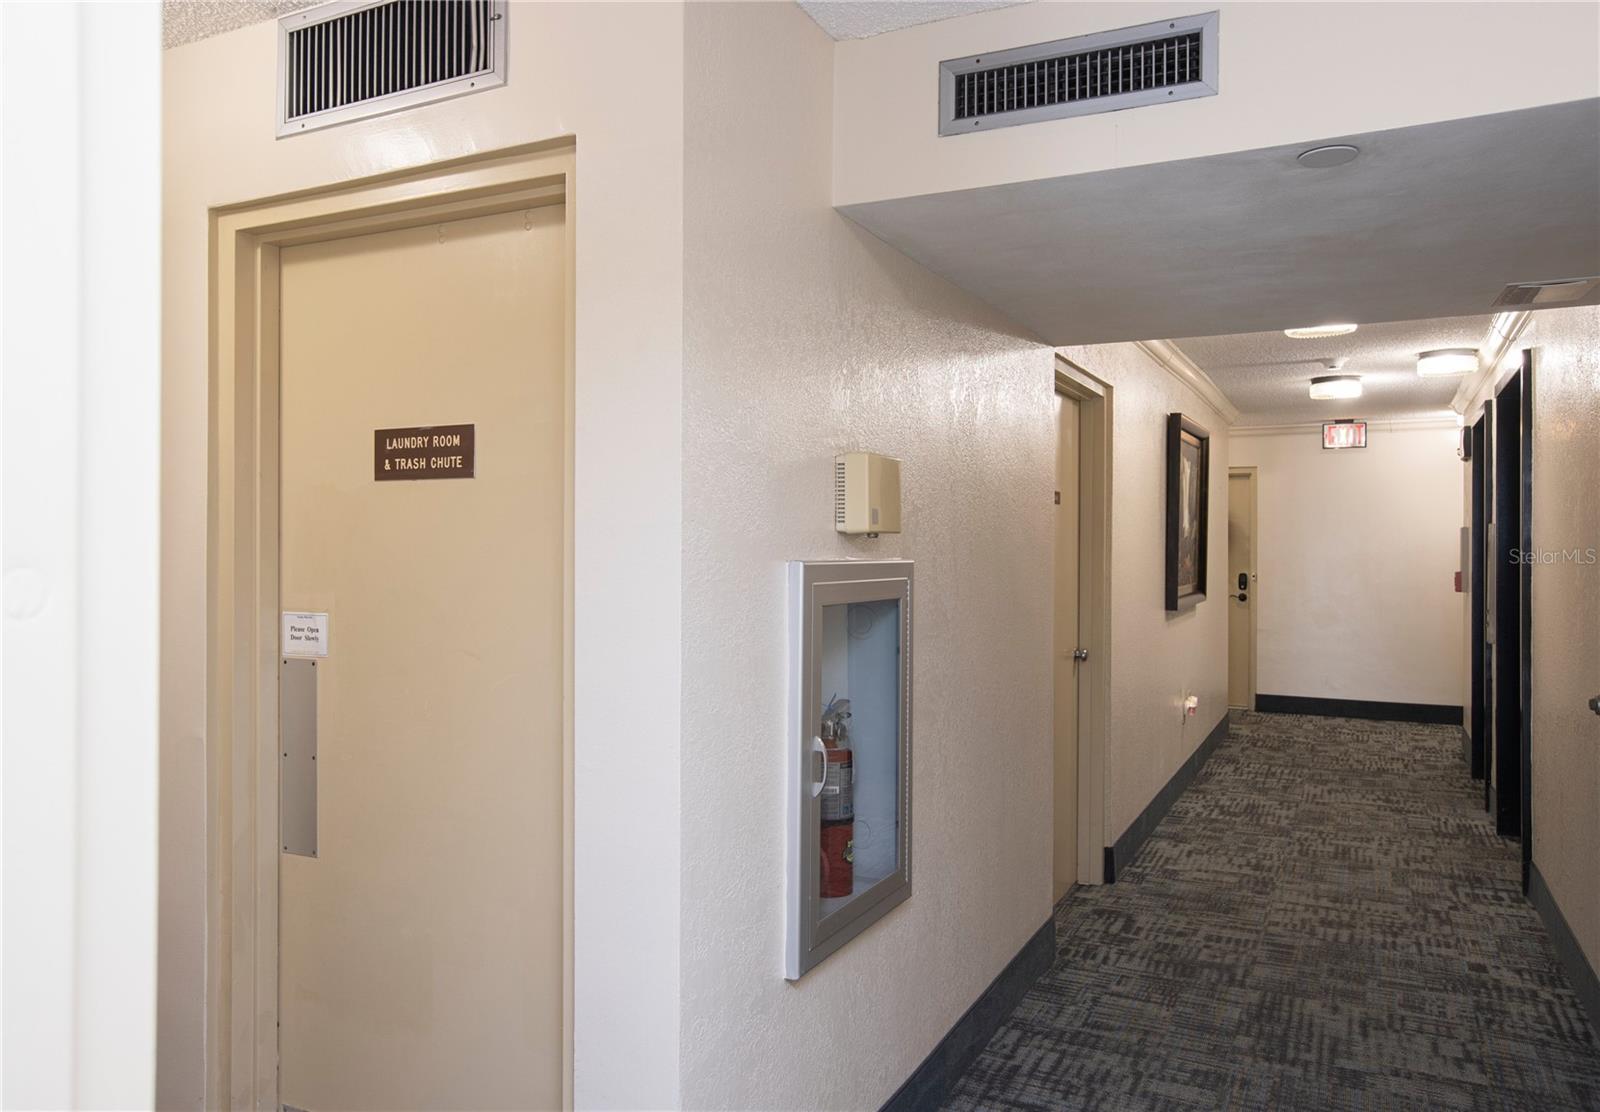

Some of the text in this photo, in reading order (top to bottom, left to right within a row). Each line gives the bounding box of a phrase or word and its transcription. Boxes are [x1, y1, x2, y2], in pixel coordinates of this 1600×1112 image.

[386, 434, 460, 450] LAUNDRY ROOM
[384, 456, 463, 471] & TRASH CHUTE
[306, 626, 320, 634] Open
